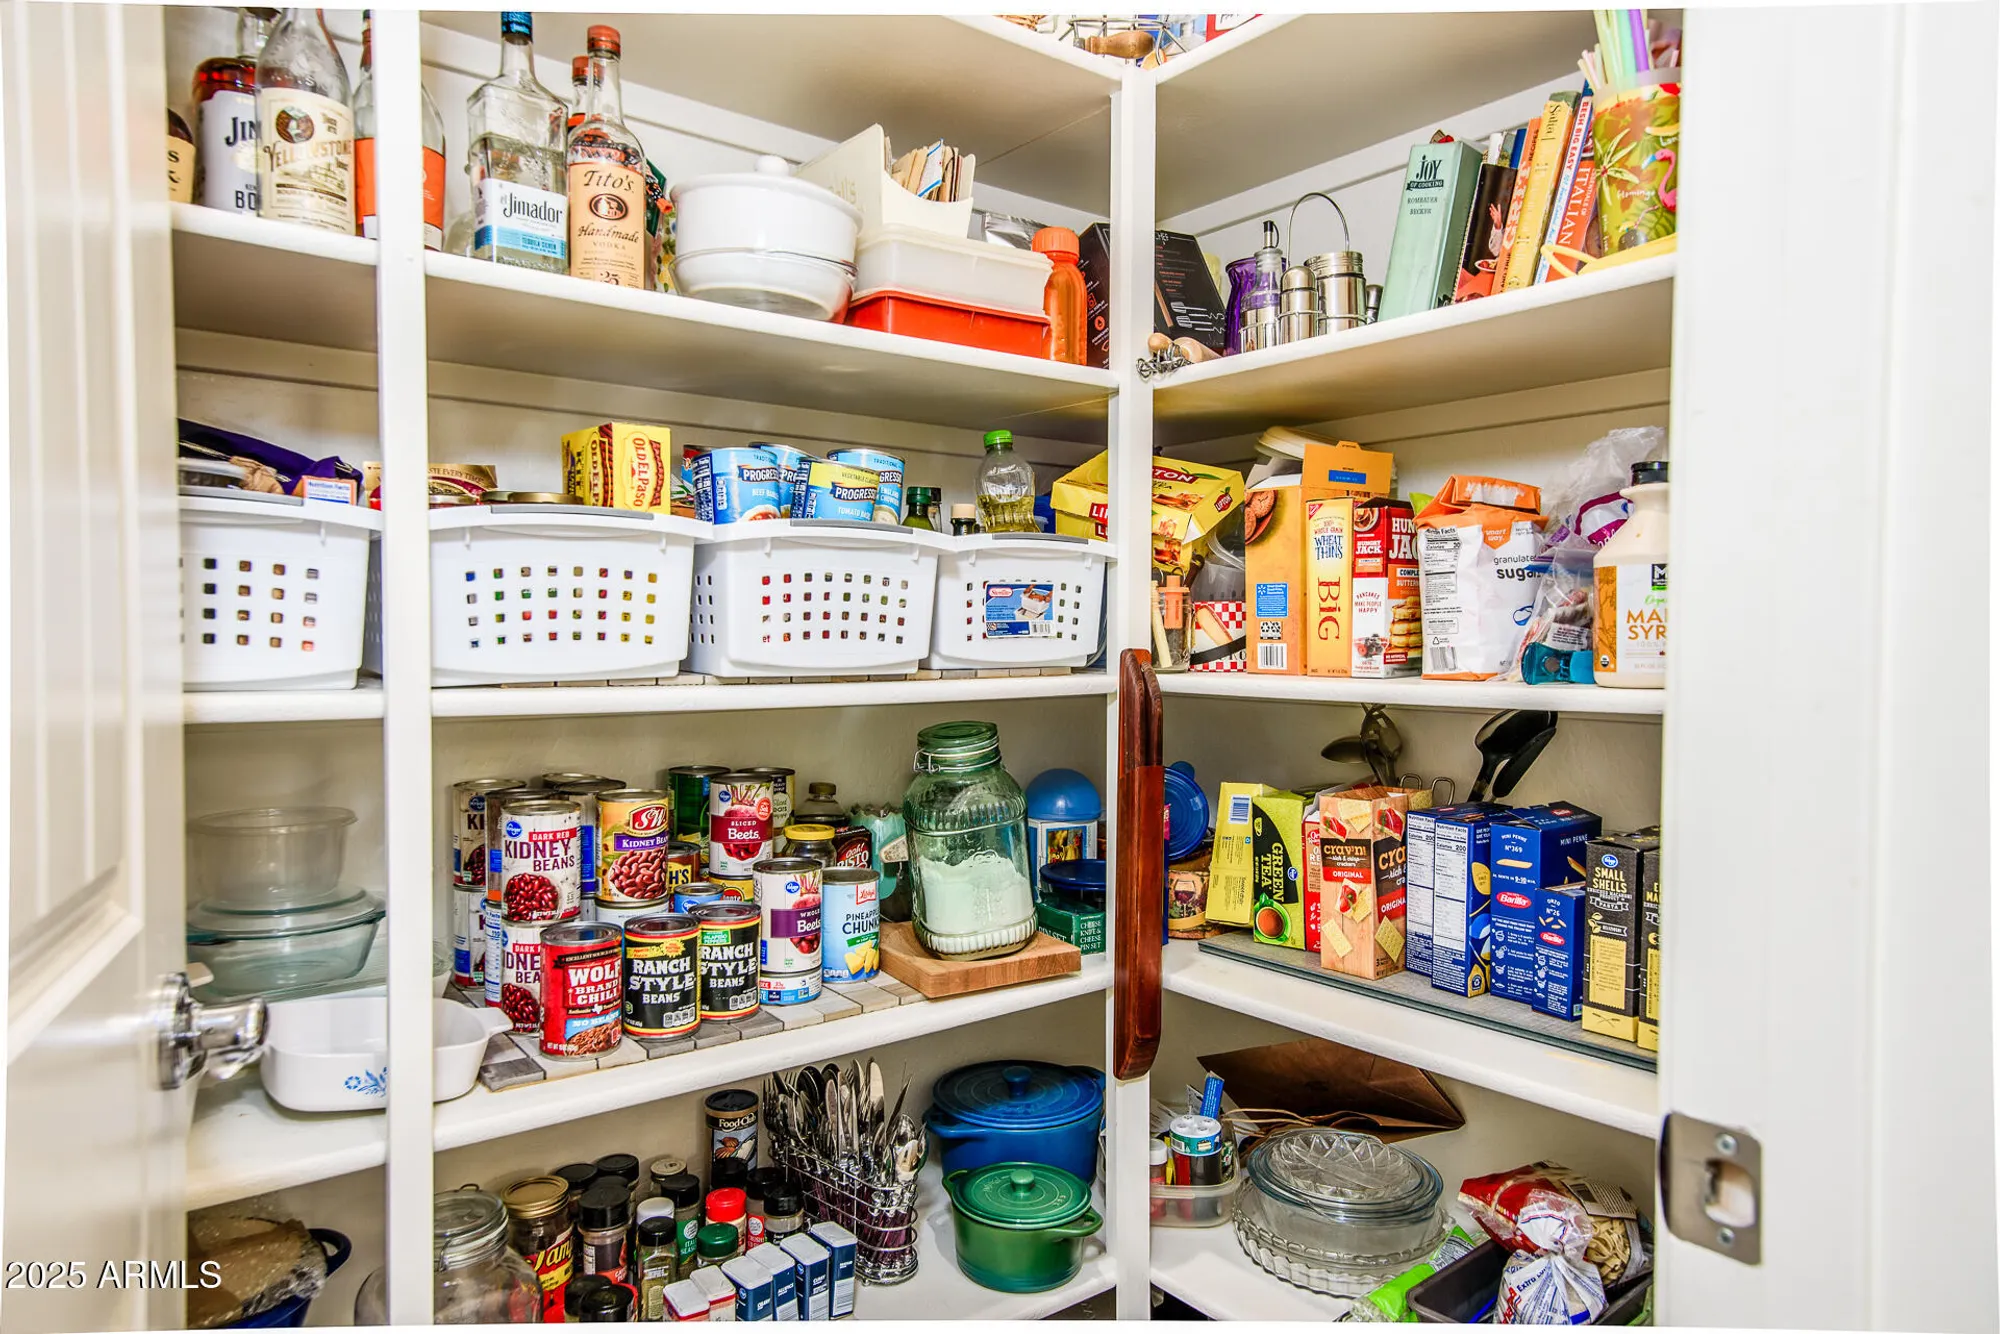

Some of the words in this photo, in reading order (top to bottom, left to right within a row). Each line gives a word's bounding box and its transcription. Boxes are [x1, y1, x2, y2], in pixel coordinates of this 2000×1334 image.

[1578, 101, 1589, 126] BESH
[1573, 128, 1583, 143] BIG
[1566, 146, 1578, 170] EASY
[584, 169, 632, 193] Tito's
[1616, 188, 1656, 201] flamingo
[503, 192, 563, 224] Jimador
[1559, 167, 1592, 245] ITALIAN
[577, 222, 639, 244] Handmade
[592, 241, 627, 251] VODKA
[632, 437, 646, 461] OLD
[442, 468, 462, 479] EVERY
[1152, 468, 1193, 483] TON
[1215, 494, 1232, 511] LIPTON
[1314, 535, 1343, 547] WHEAT
[1315, 545, 1343, 560] THINS
[1355, 545, 1383, 555] JACK
[1627, 625, 1667, 640] SYR
[532, 832, 553, 841] DARK
[556, 830, 570, 839] RED
[1512, 833, 1528, 842] PENNE
[1560, 838, 1572, 846] MINI
[1572, 834, 1588, 843] PENNE
[504, 838, 571, 859] KIDNEY
[622, 839, 655, 848] KIDNEY
[533, 855, 575, 872] BEANS
[1379, 846, 1406, 871] cra
[669, 868, 689, 885] H'S
[1261, 853, 1272, 888] TEA
[1271, 842, 1285, 903] GREEN
[1594, 866, 1625, 882] SMALL
[1592, 878, 1627, 894] SHELLS
[1500, 894, 1529, 906] Barilla
[1599, 901, 1619, 910] PASTA
[1080, 920, 1101, 929] CHEESE
[1080, 929, 1096, 937] KNIFE
[1080, 935, 1101, 943] CHEESE
[1542, 934, 1563, 945] Barilla
[514, 945, 535, 953] DARK
[702, 942, 754, 961] RANCH
[506, 951, 540, 971] DNE
[566, 952, 592, 962] EXCELLENT
[568, 958, 621, 987] WOLF
[633, 956, 691, 975] RANCH
[700, 957, 757, 976] STYLE
[515, 971, 540, 984] BEA
[628, 972, 695, 992] STYLE
[710, 976, 745, 988] BEANS
[574, 979, 618, 995] BRAND
[577, 988, 617, 1005] CHILI
[642, 991, 681, 1004] BEANS
[572, 1019, 588, 1027] NO
[718, 1118, 740, 1128] Food
[1516, 1276, 1537, 1293] Extra
